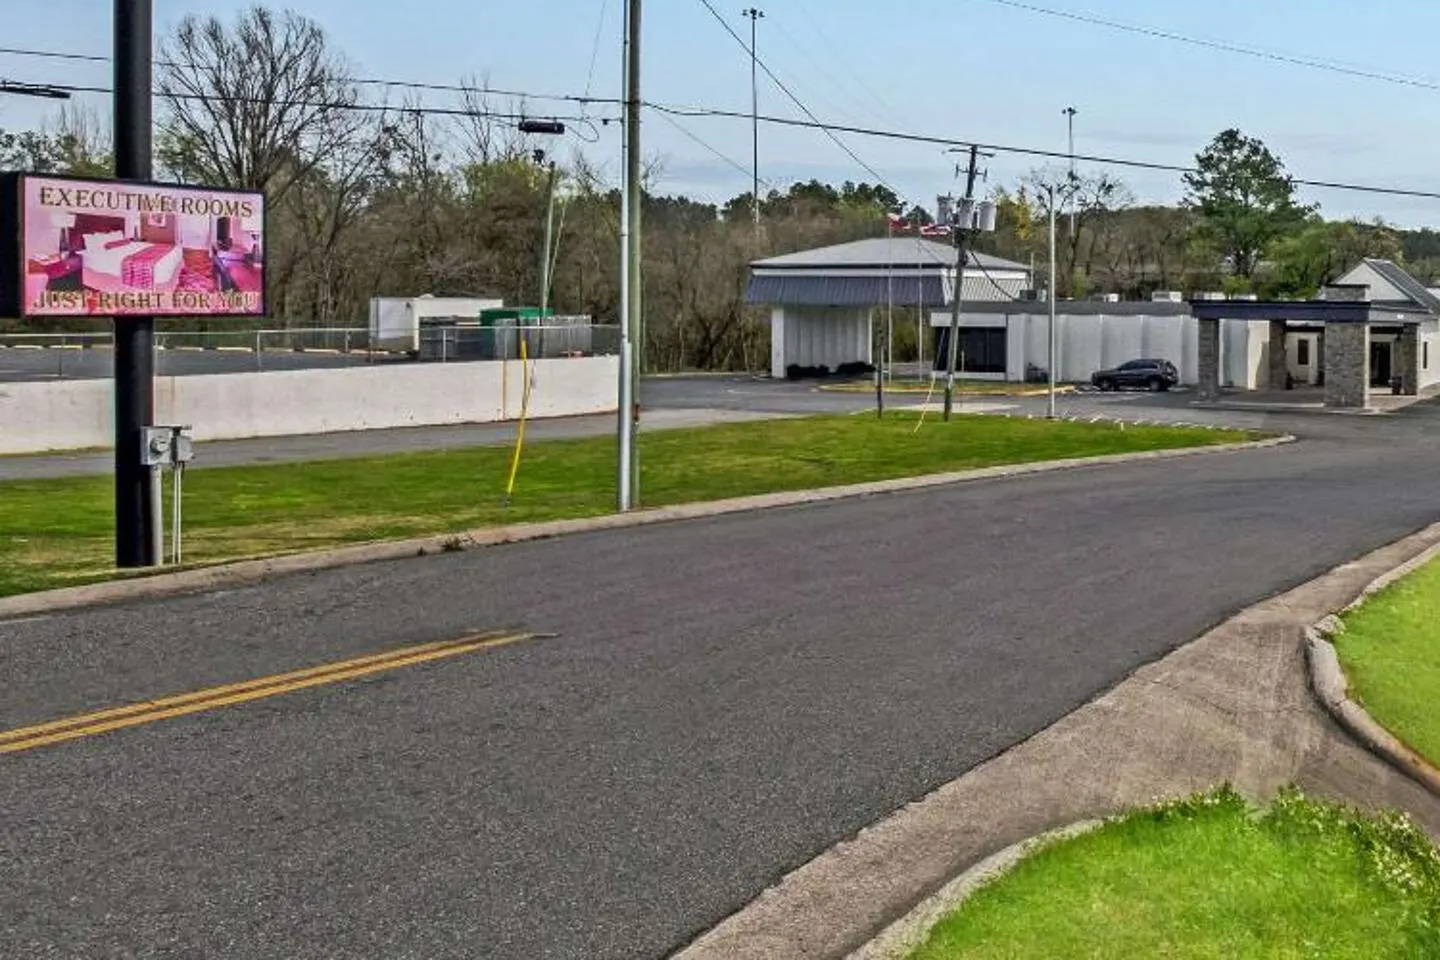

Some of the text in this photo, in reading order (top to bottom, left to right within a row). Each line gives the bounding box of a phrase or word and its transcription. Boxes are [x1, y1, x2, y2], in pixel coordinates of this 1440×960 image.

[39, 186, 253, 217] EXECUTIVE ROOMS
[33, 290, 94, 309] JUST
[99, 291, 164, 310] RIGHT
[172, 292, 210, 309] FOR
